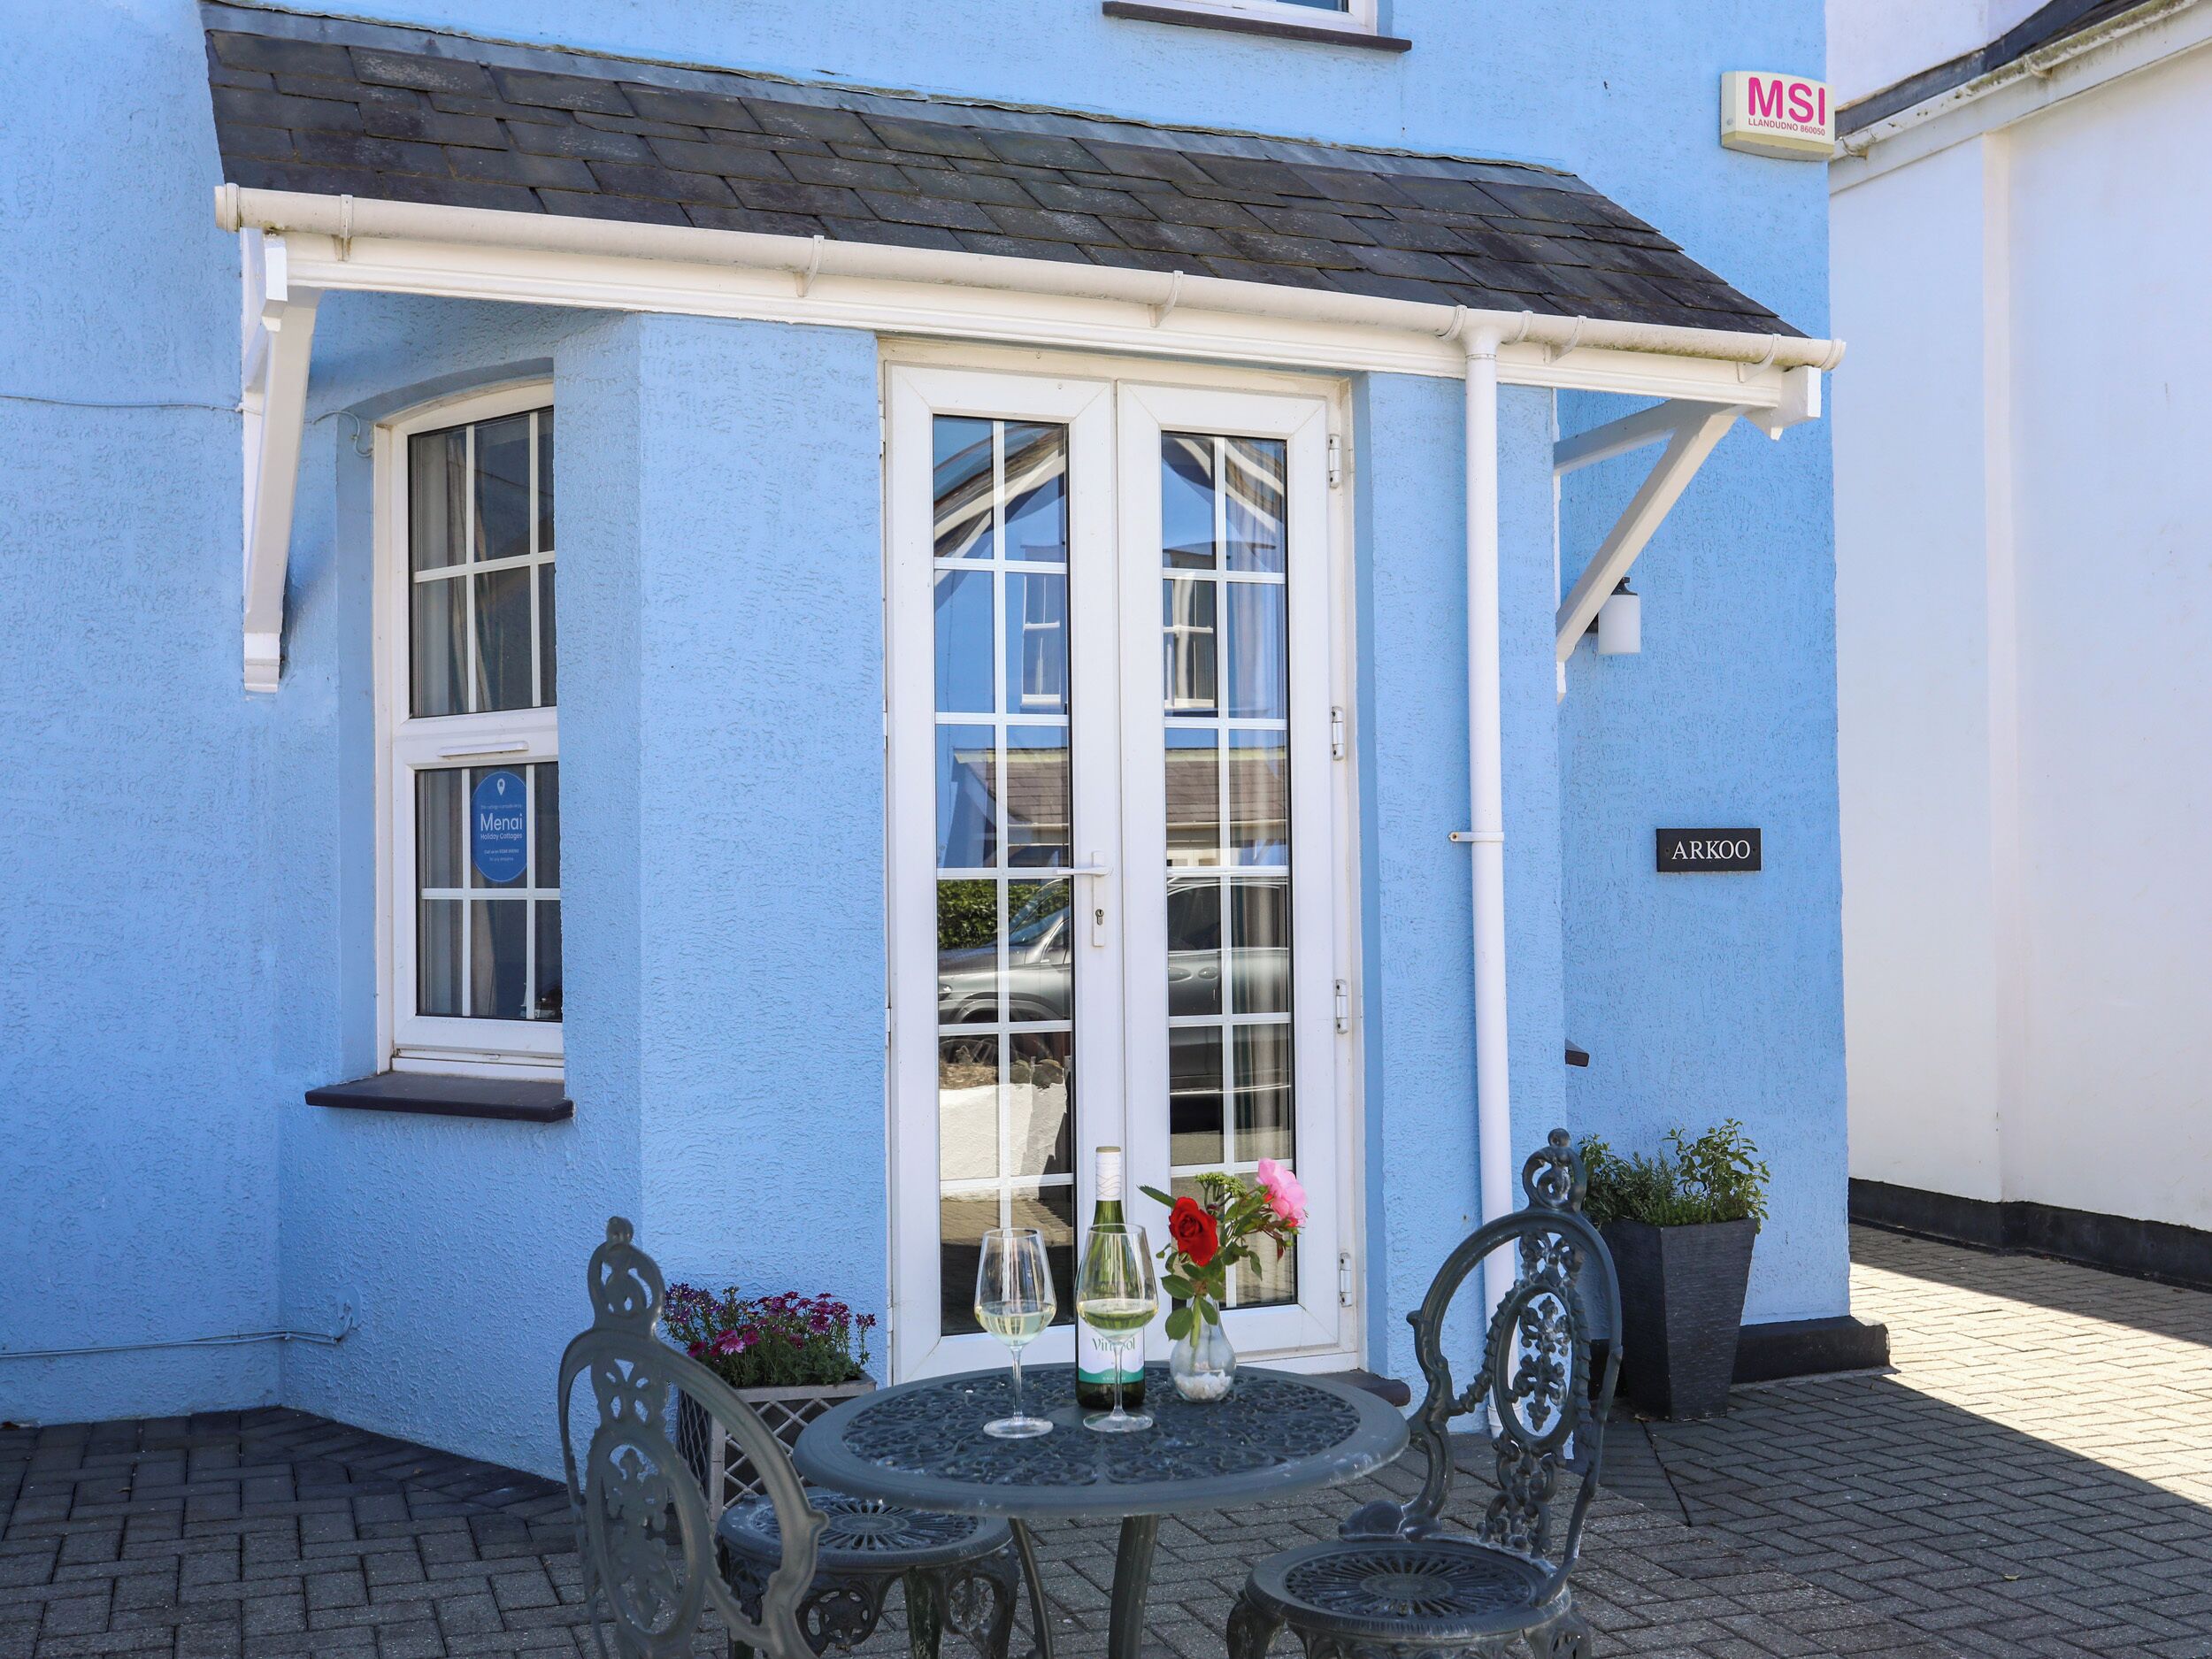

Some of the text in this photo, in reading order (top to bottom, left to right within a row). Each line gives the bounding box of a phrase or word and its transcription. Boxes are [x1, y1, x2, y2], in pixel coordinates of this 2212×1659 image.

[1748, 77, 1825, 127] MSI
[1748, 118, 1825, 135] LLANDUDNO 860050
[480, 812, 523, 831] Menai
[480, 833, 499, 841] Holiday
[1671, 840, 1751, 860] ARKOO
